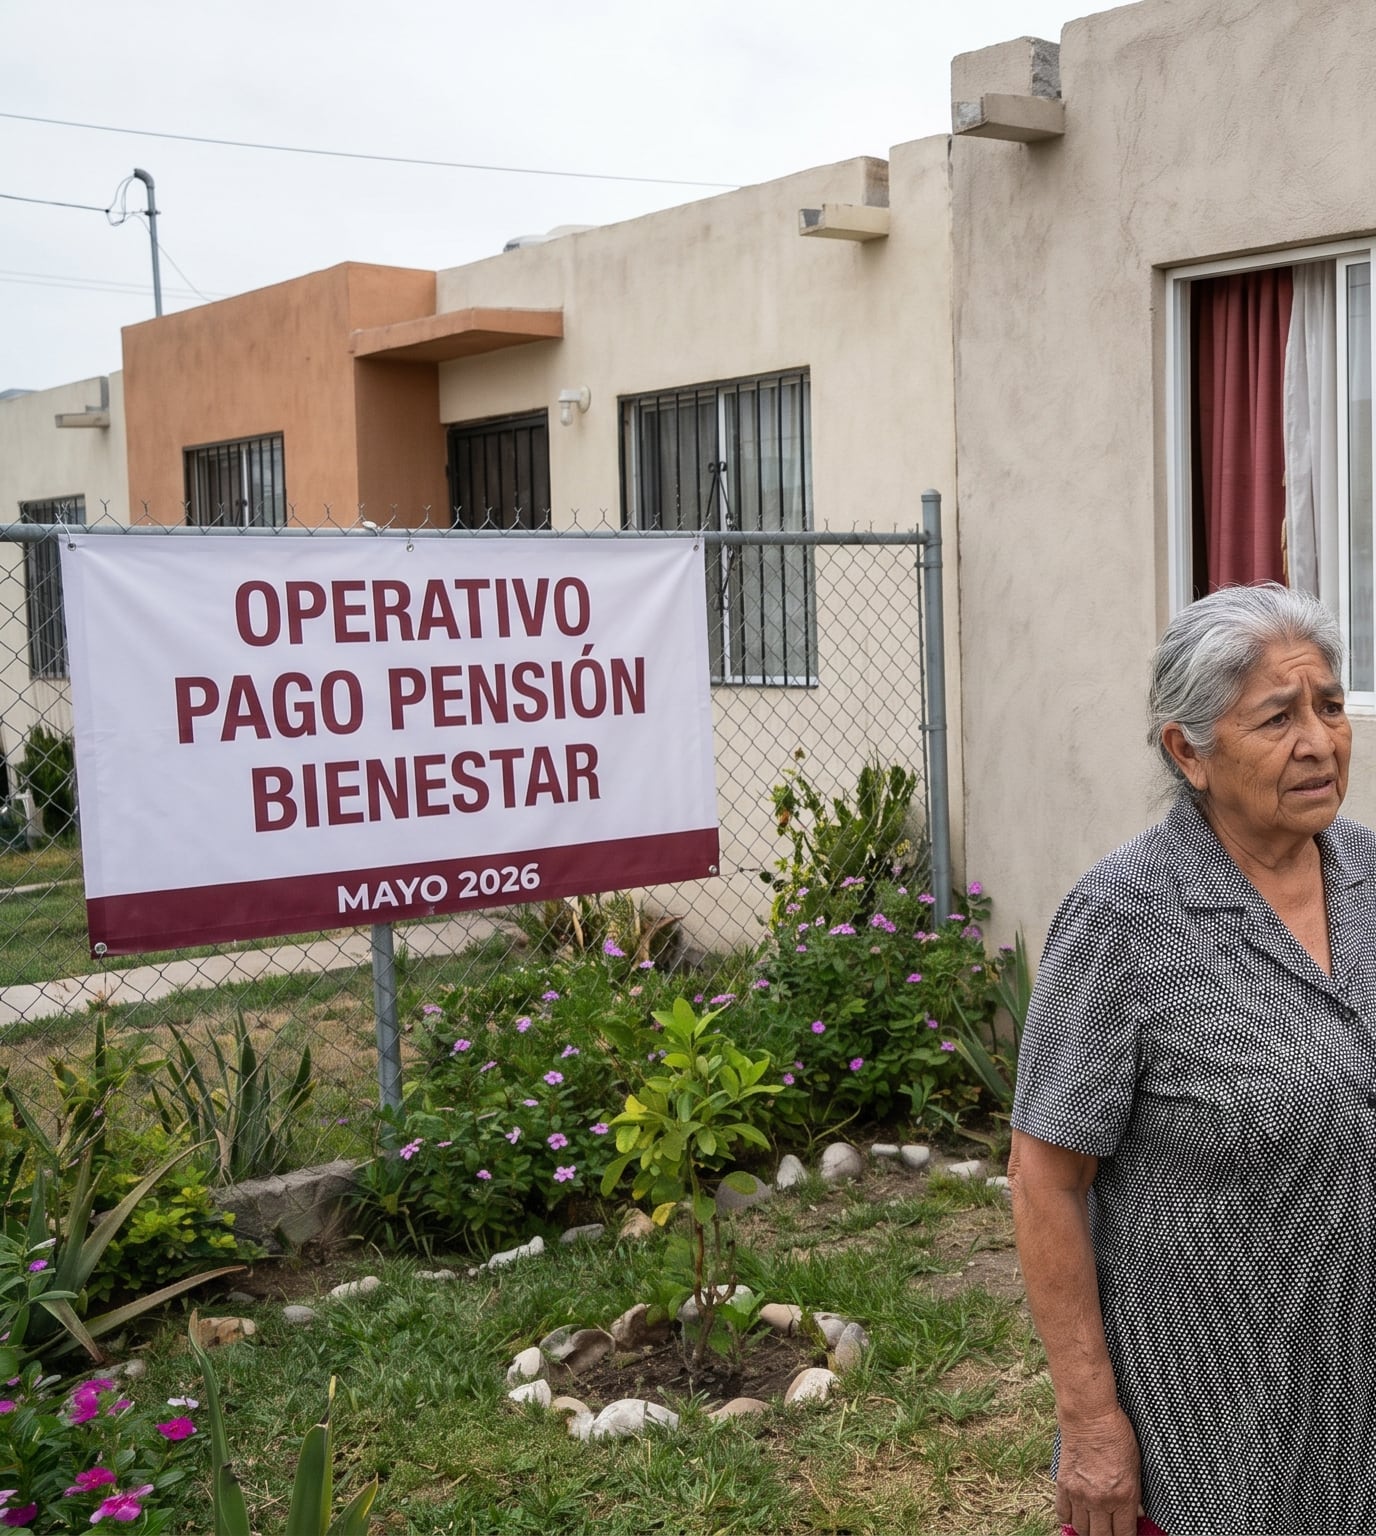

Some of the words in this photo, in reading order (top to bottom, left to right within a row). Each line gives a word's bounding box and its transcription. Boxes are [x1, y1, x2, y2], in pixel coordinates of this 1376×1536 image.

[236, 577, 591, 648] OPERATIVO
[174, 669, 364, 744] PAGO
[388, 643, 645, 730] PENSIÓN
[251, 743, 600, 833] BIENESTAR
[336, 874, 449, 914] MAYO
[458, 863, 541, 899] 2026
